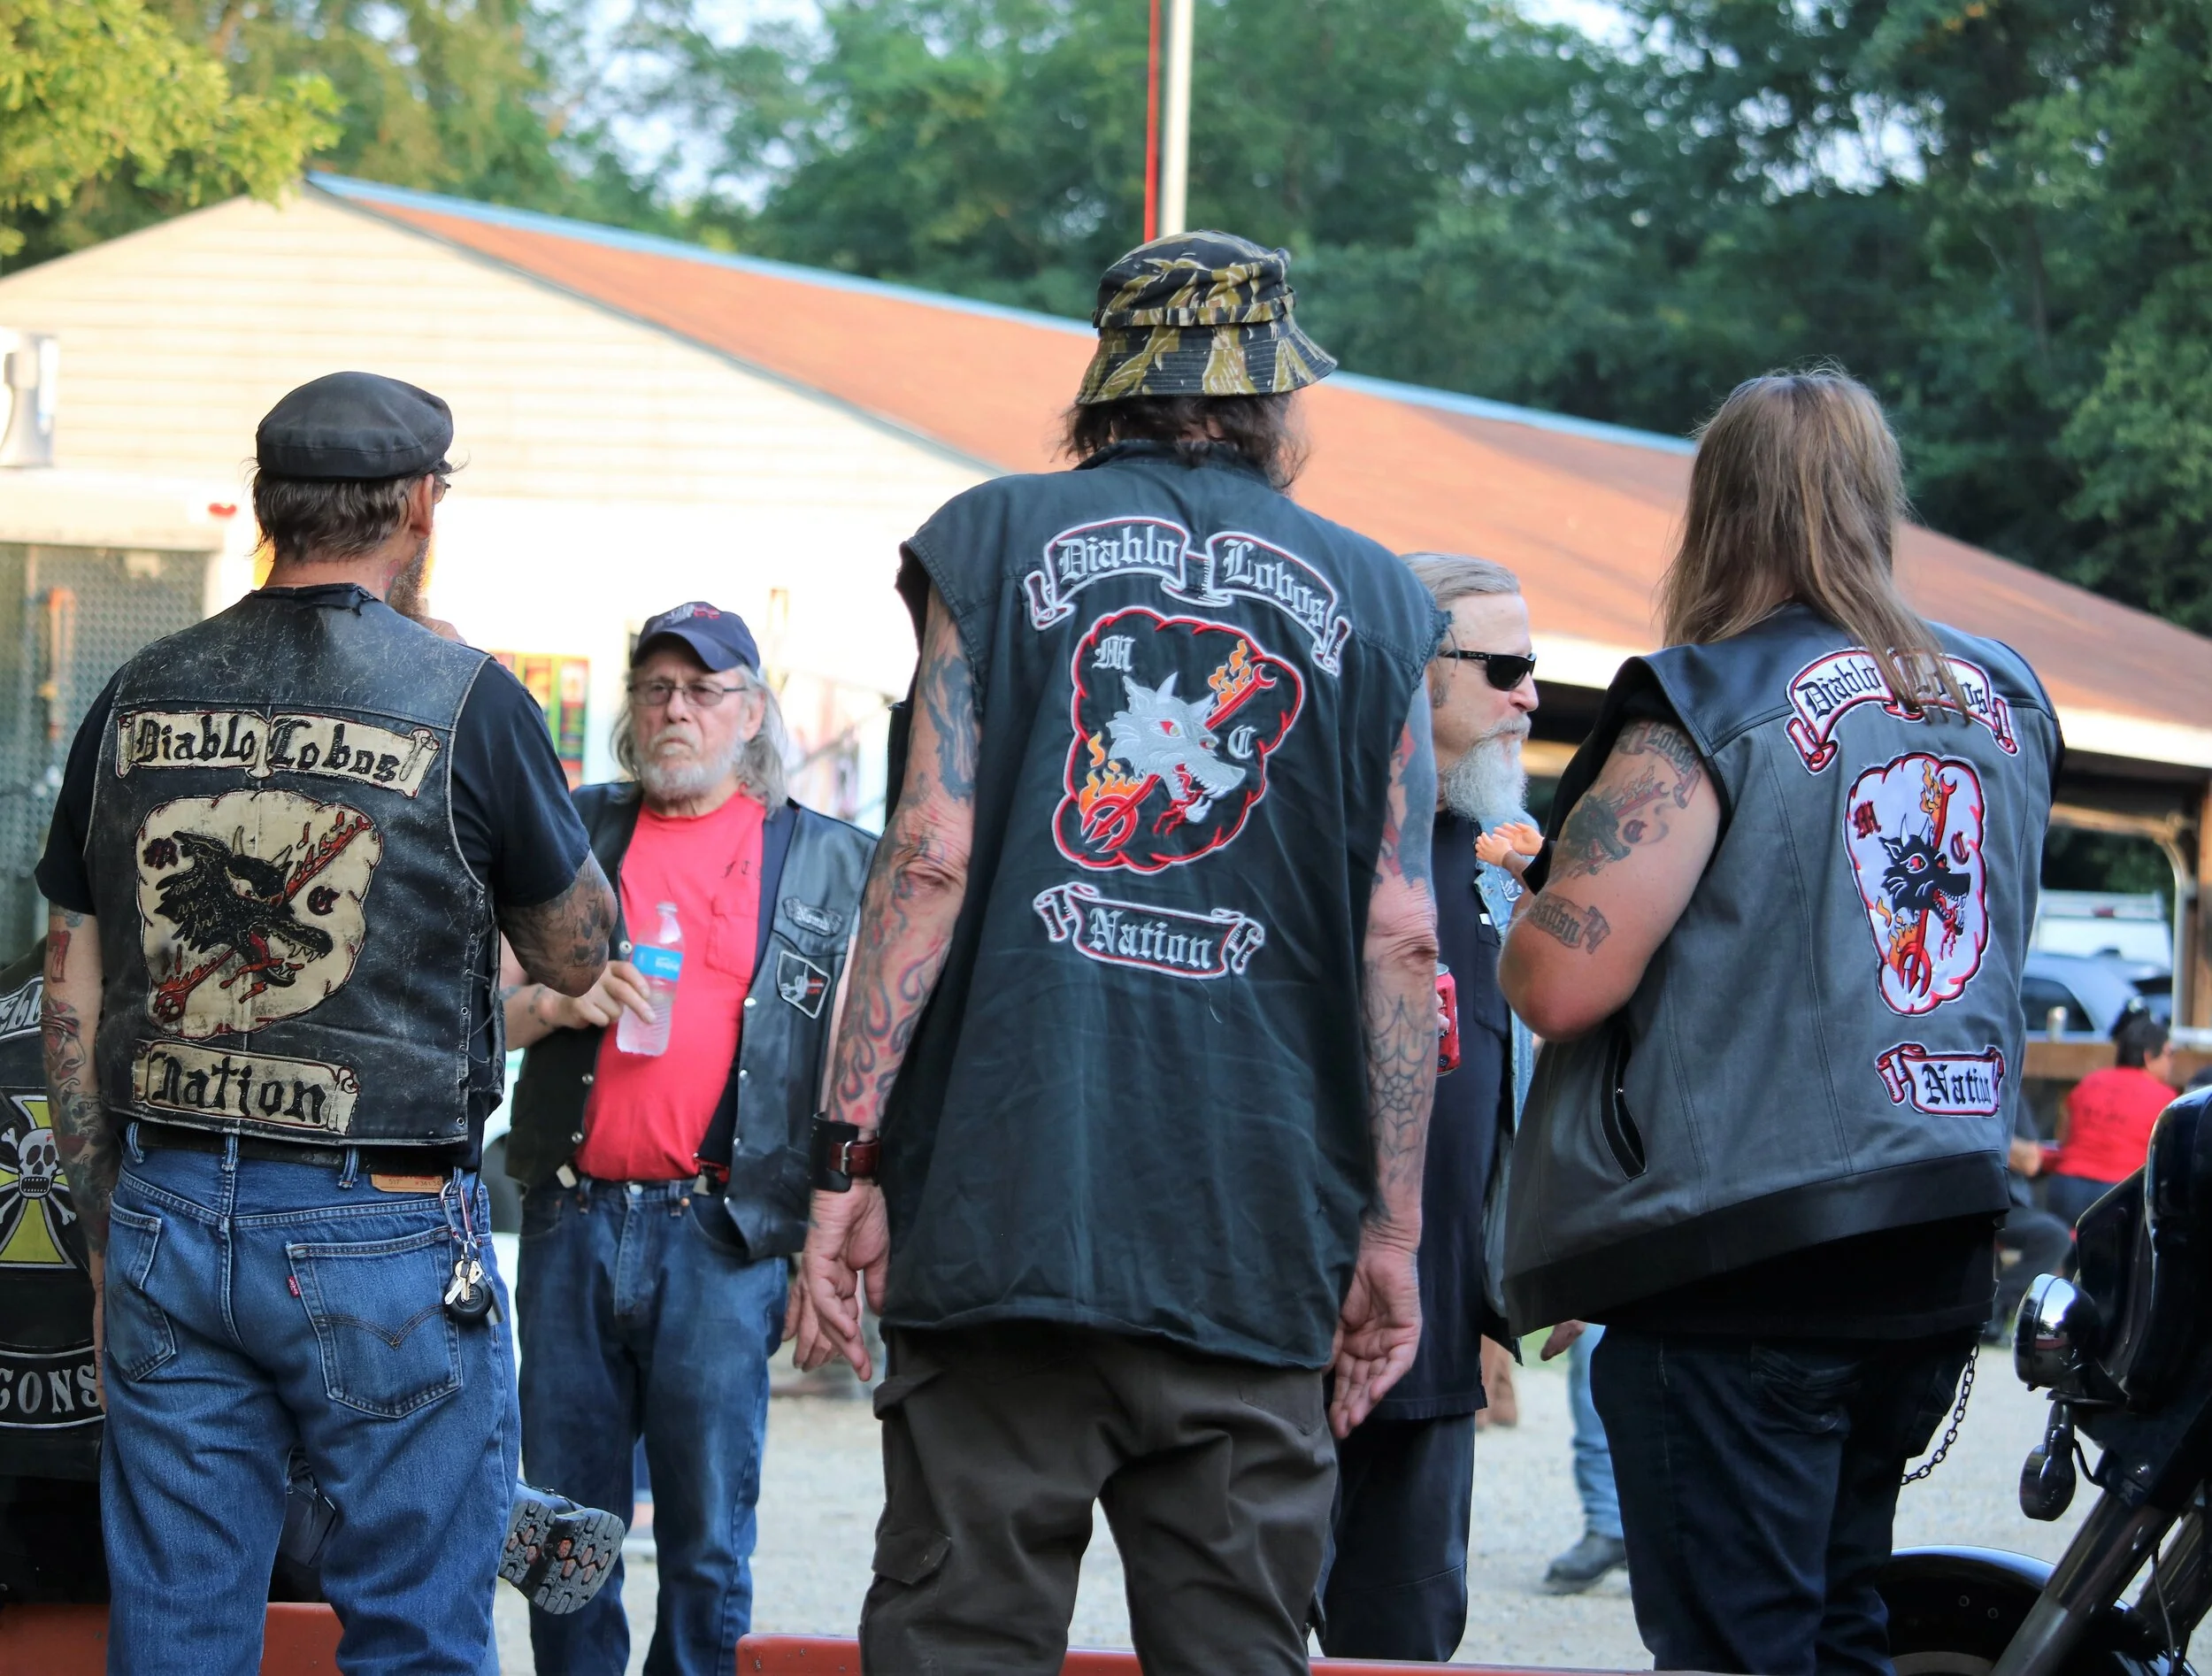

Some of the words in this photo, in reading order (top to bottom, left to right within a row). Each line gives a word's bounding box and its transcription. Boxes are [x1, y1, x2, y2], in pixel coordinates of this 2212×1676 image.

[1057, 526, 1179, 580] Diablo
[1223, 539, 1325, 630] Lobos
[1092, 634, 1136, 672] M
[1795, 657, 1882, 721] Diablo
[136, 713, 256, 762] Diablo
[267, 718, 402, 782] Lobos
[1089, 907, 1213, 970] Nation
[150, 1052, 327, 1126] Nation
